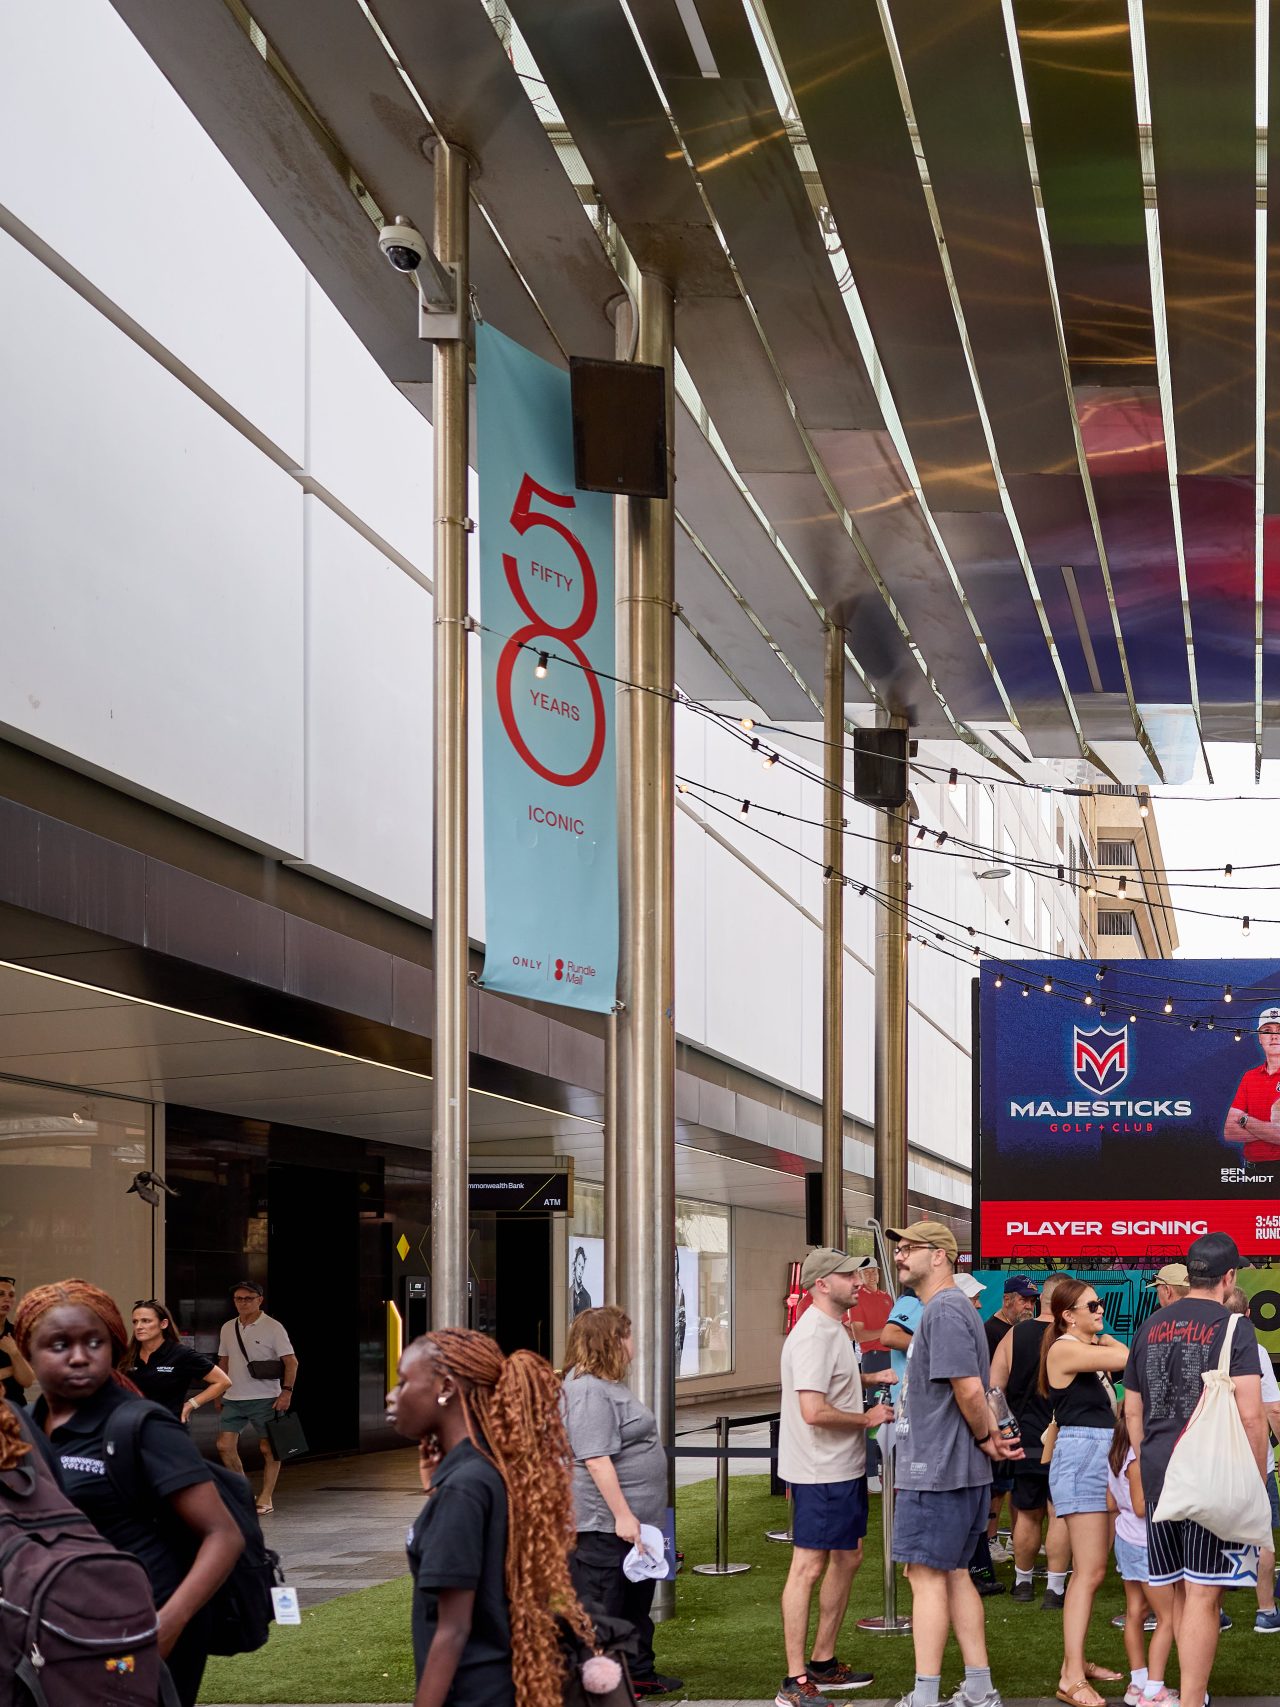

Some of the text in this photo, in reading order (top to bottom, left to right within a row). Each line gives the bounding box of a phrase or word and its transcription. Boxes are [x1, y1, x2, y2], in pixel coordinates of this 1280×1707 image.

[530, 561, 574, 591] FIFTY
[529, 689, 581, 721] YEARS
[527, 805, 585, 835] ICONIC
[512, 956, 542, 970] ONLY
[567, 960, 596, 977] Rundle
[565, 971, 583, 985] Mall
[1010, 1101, 1192, 1118] MAJESTICKS
[1050, 1123, 1153, 1133] GOLF CLUB
[467, 1182, 508, 1190] mmonwealth
[1220, 1175, 1274, 1183] SCHMIDT
[544, 1198, 561, 1206] ATM
[1007, 1220, 1208, 1235] PLAYER SIGNING
